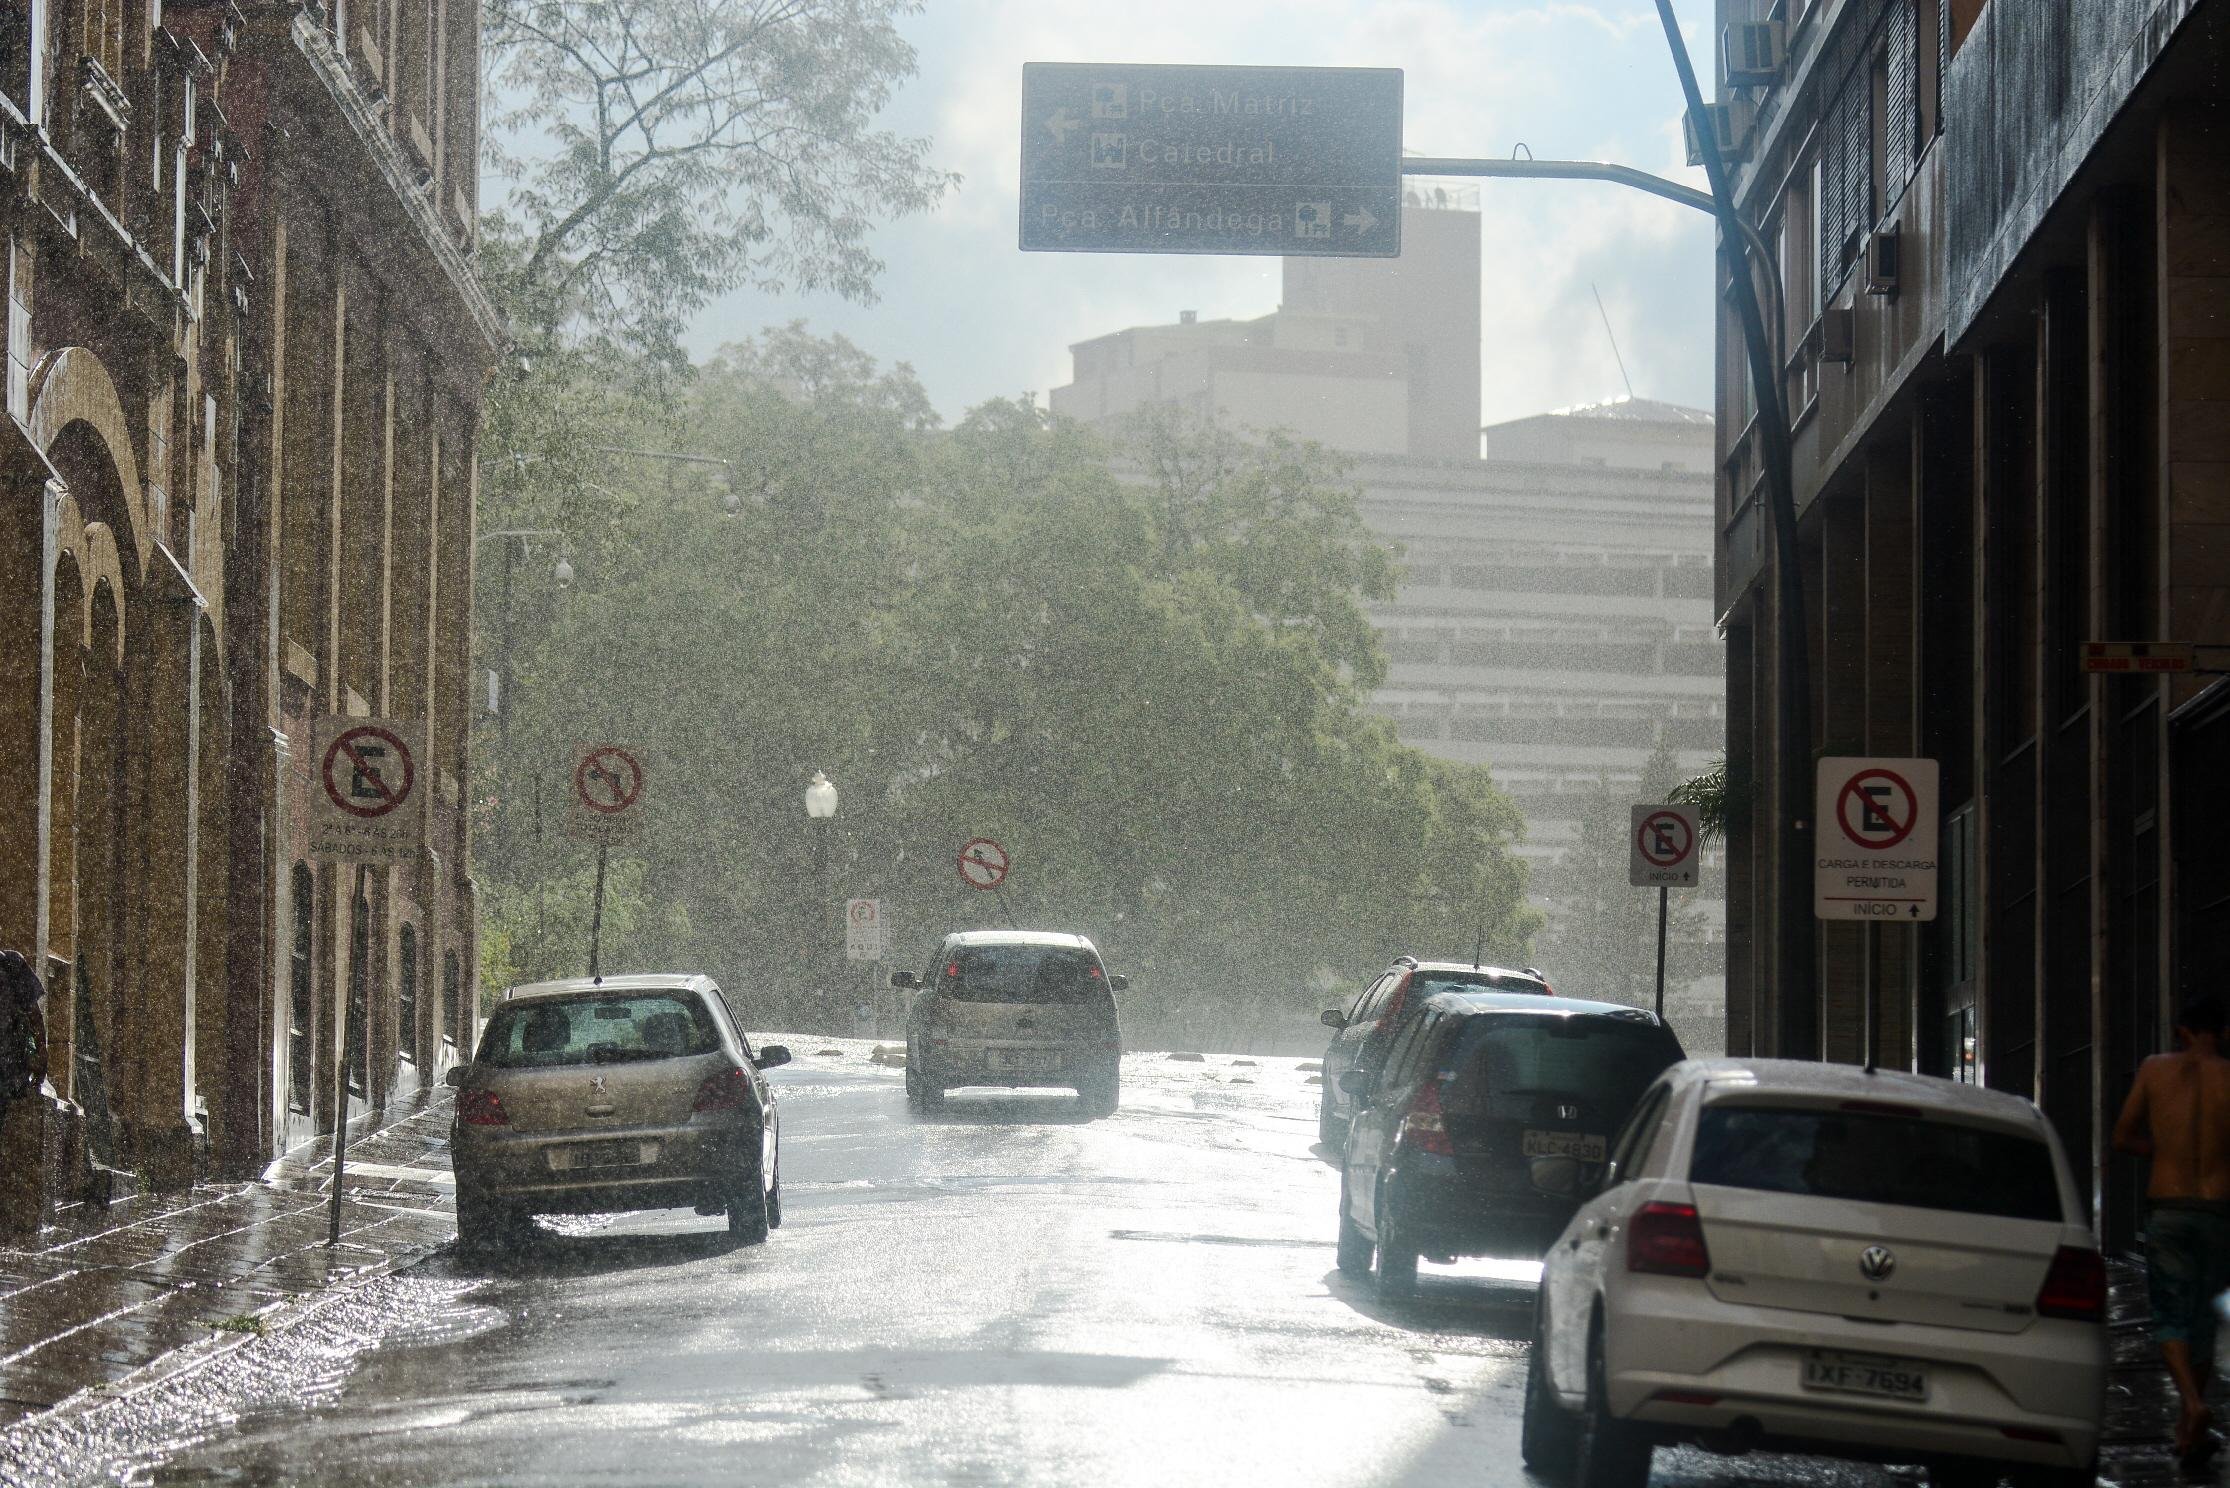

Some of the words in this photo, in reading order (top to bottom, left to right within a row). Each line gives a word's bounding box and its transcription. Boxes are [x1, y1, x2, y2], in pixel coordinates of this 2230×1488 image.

[1212, 89, 1313, 115] Matriz
[1139, 138, 1273, 164] Catedral
[1818, 858, 1860, 869] CARGA
[1862, 859, 1870, 869] E
[1872, 860, 1937, 871] DESCARGA
[1847, 876, 1907, 889] PERMITIDA
[1854, 900, 1898, 916] INÍCIO
